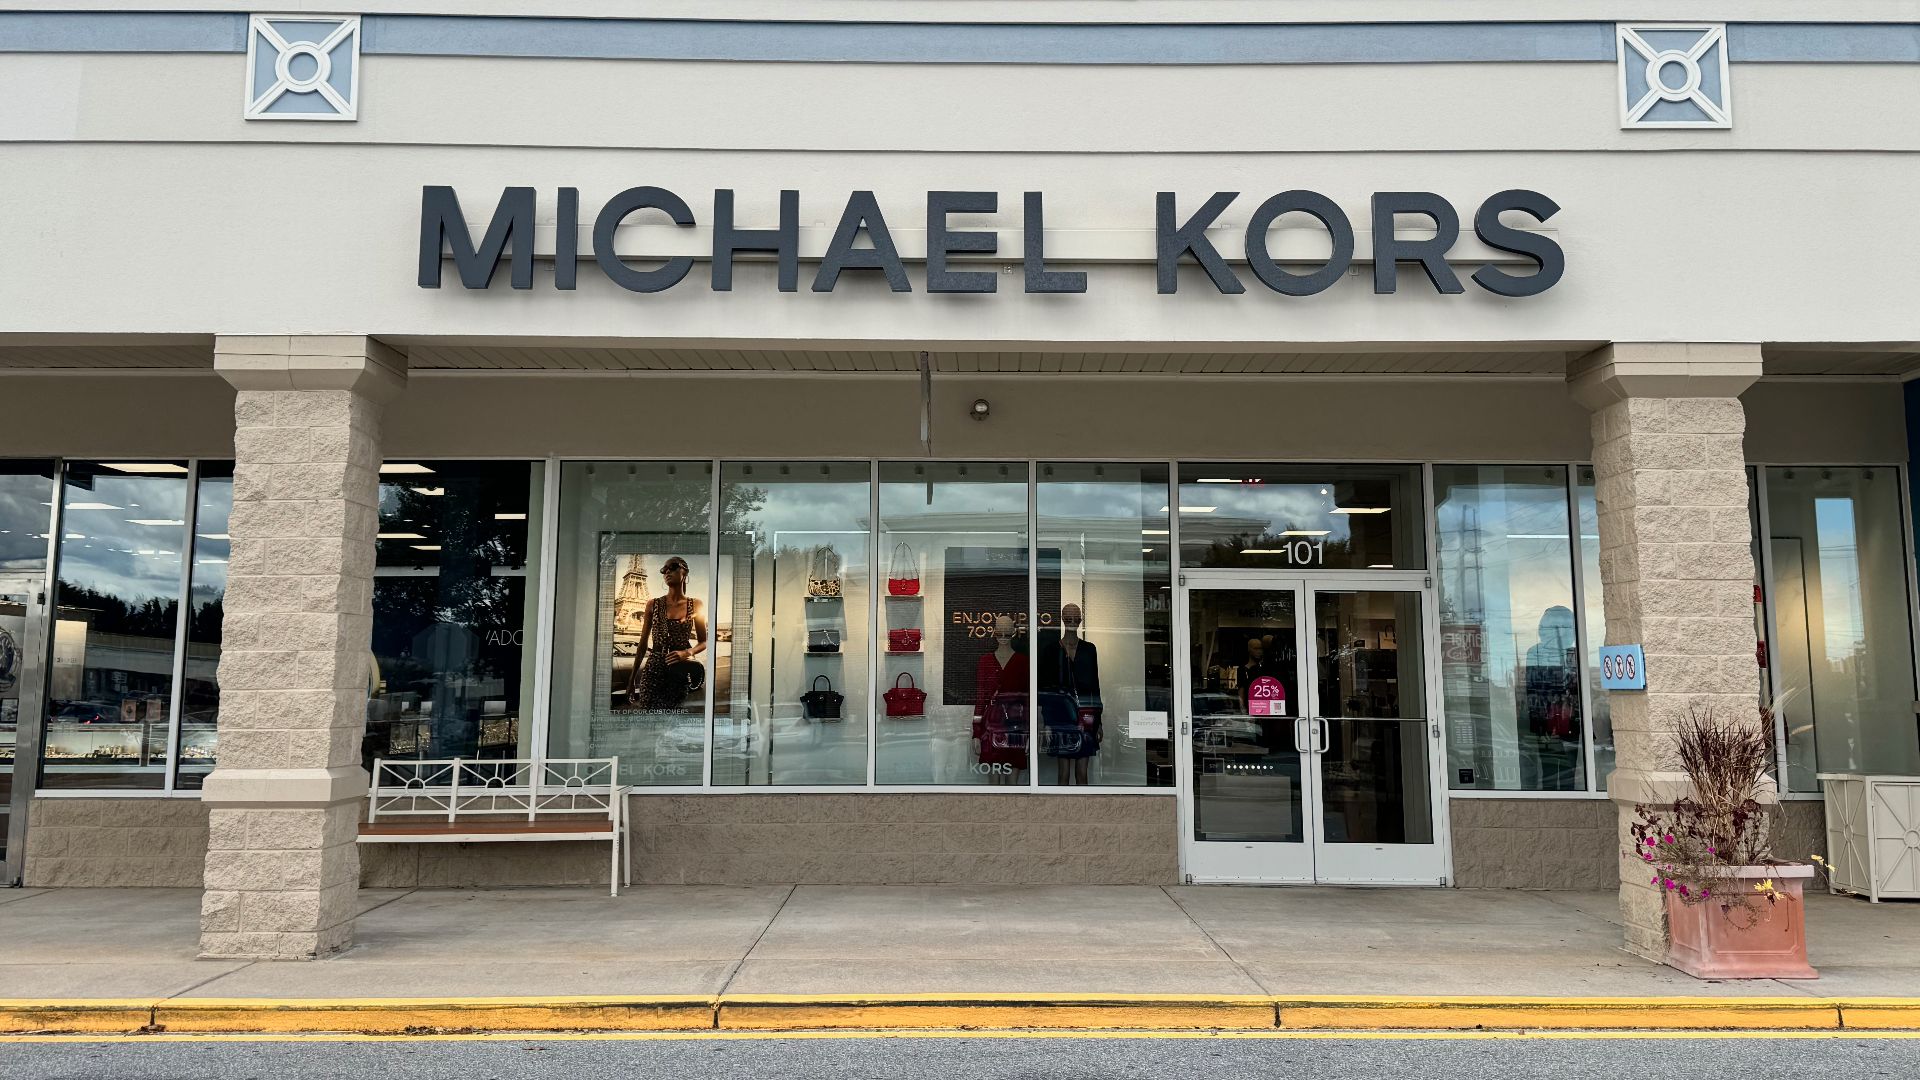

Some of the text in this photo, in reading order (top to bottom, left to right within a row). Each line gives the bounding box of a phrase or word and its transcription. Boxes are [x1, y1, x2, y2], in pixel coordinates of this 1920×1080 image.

[418, 185, 1565, 297] MICHAEL KORS
[1283, 541, 1323, 565] 101
[953, 612, 1002, 624] ENJOY
[1254, 685, 1280, 698] 25%
[969, 762, 1013, 775] KORS
